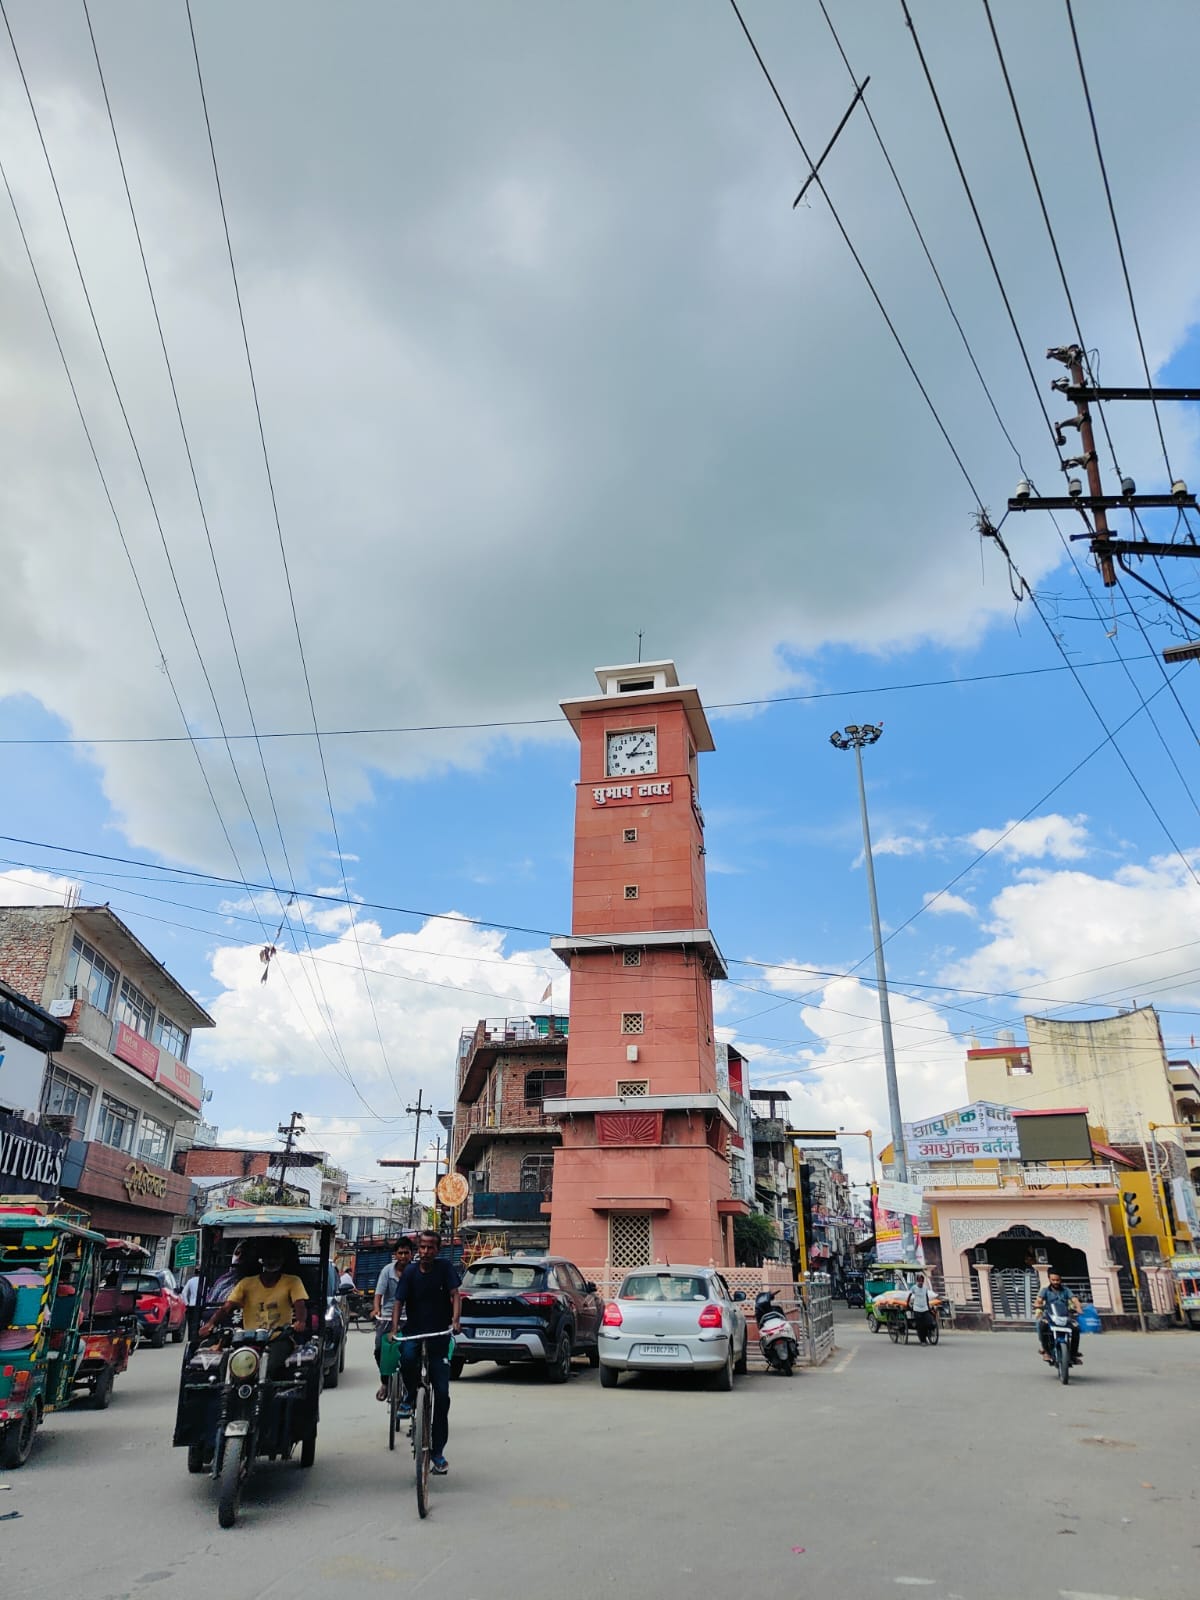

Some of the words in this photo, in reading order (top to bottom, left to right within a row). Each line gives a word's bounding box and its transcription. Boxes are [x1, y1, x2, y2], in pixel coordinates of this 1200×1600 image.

[592, 785, 633, 805] सुभाष
[637, 782, 671, 797] टावर
[911, 1109, 977, 1138] आधुनिक
[919, 1140, 980, 1158] आधुनिक
[982, 1138, 1013, 1153] बर्तन
